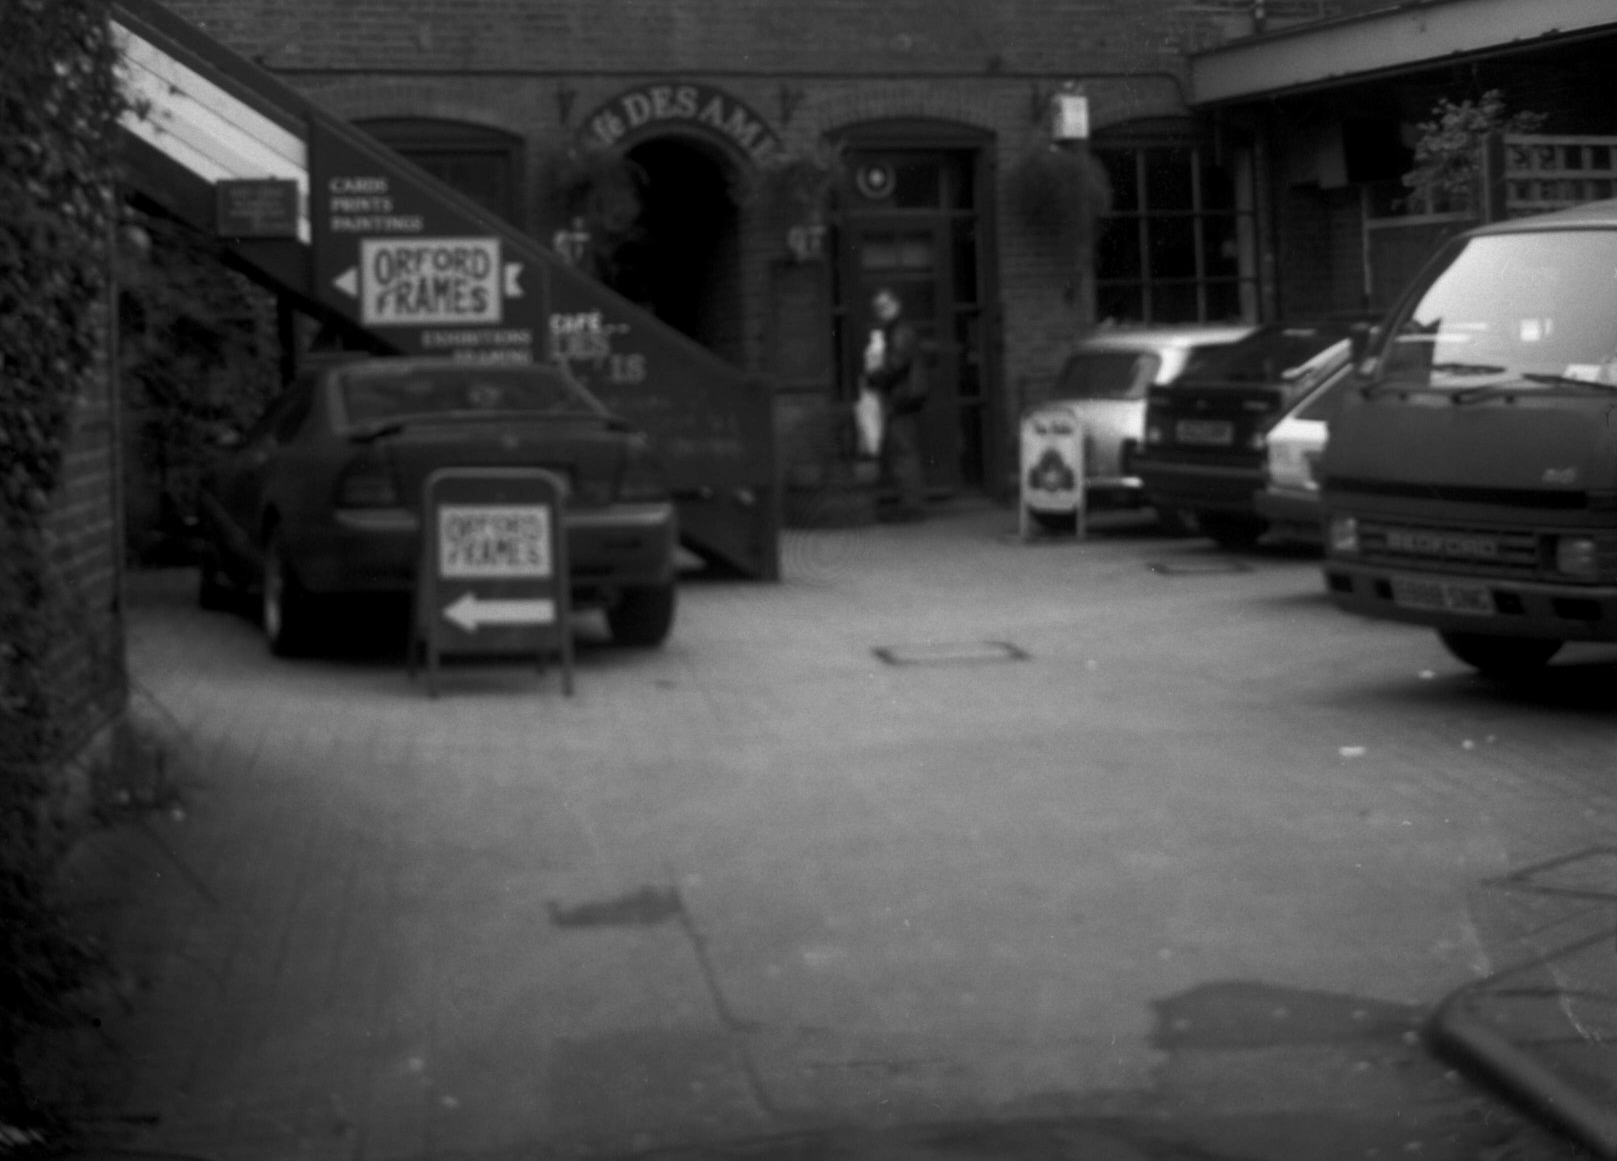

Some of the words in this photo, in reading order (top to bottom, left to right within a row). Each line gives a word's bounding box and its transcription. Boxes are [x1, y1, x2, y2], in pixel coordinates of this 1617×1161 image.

[621, 86, 700, 127] DES
[329, 177, 388, 193] CARDS
[330, 197, 392, 212] PRINTS
[373, 247, 491, 286] ORFORD
[376, 276, 489, 316] FRAMES
